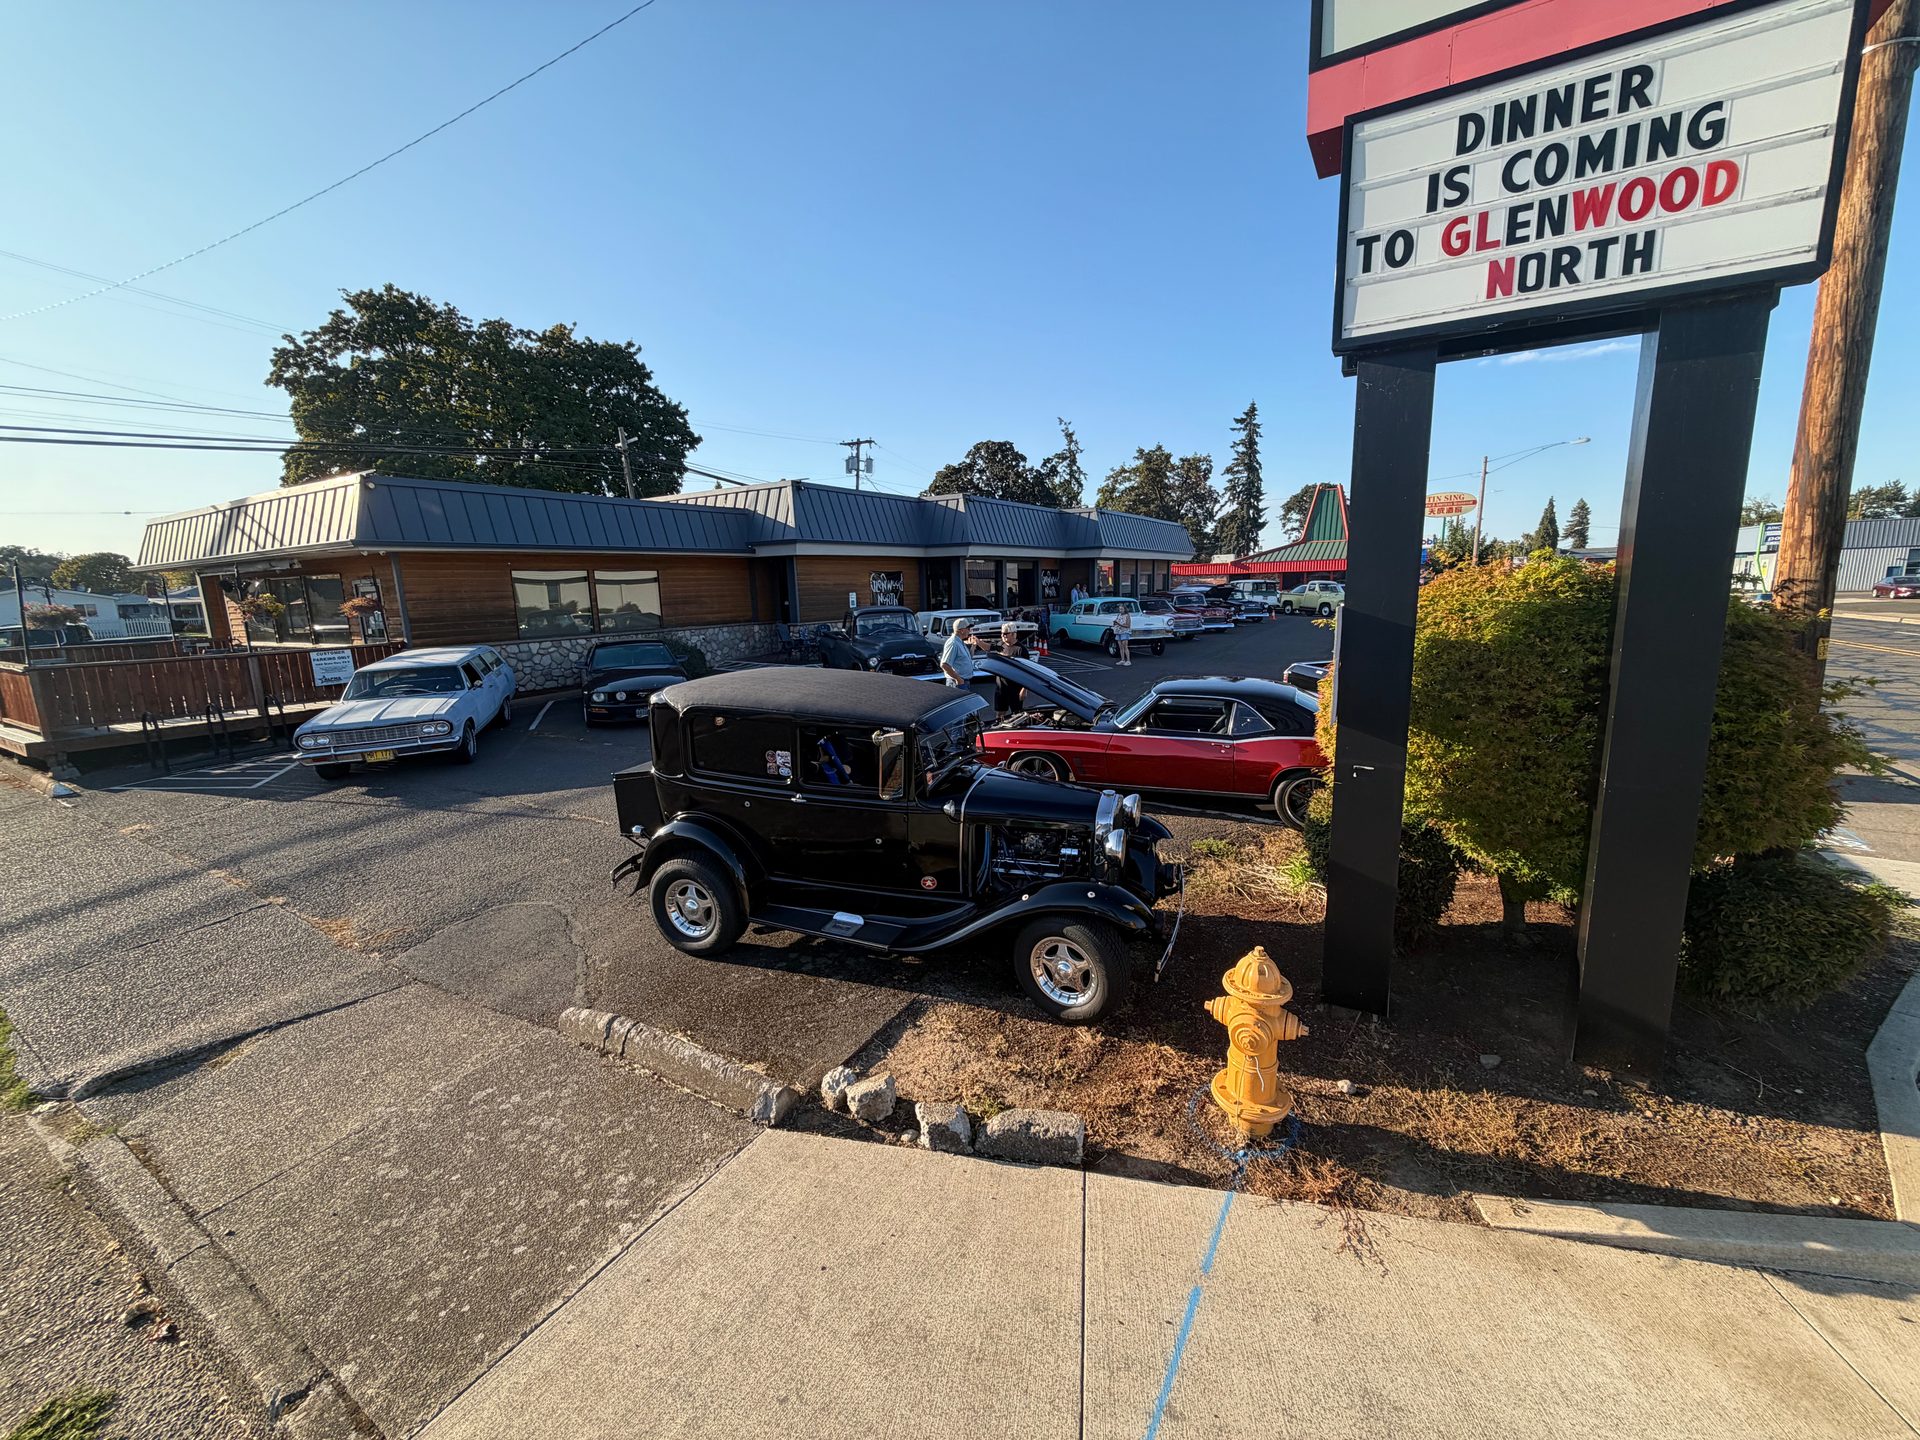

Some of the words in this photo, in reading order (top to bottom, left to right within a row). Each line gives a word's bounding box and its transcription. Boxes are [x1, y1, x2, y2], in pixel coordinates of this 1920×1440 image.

[1427, 165, 1469, 213] IS
[1502, 101, 1725, 192] COMING
[1456, 65, 1653, 155] DINNER
[1357, 230, 1414, 273] TO
[1442, 161, 1738, 256] GLENWOOD
[1487, 230, 1655, 298] NORTH
